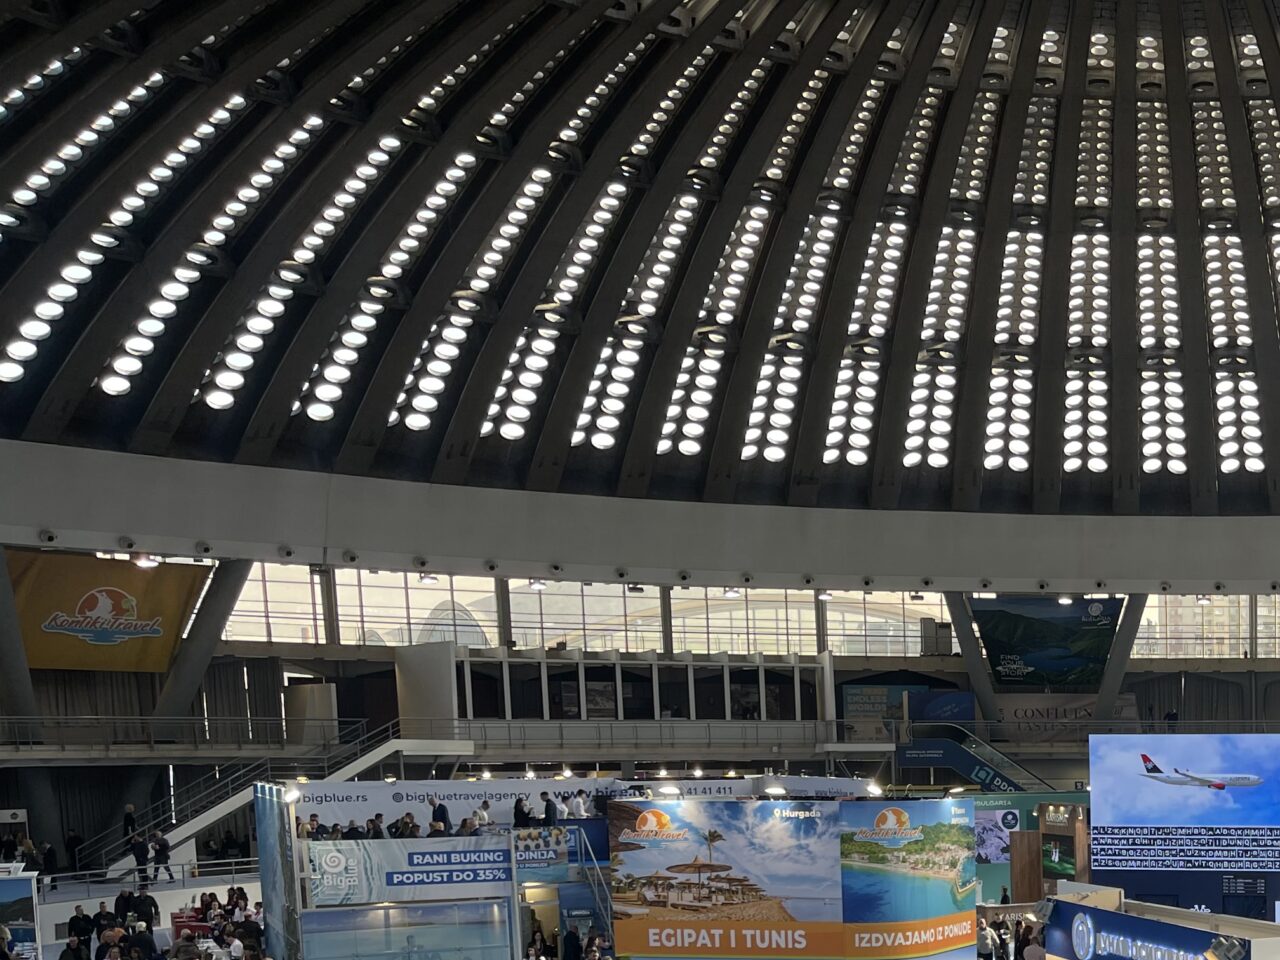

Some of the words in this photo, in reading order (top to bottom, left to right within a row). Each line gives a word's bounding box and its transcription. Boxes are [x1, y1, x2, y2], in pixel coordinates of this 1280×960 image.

[108, 616, 161, 631] Travel
[701, 785, 713, 796] 41
[715, 785, 733, 796] 411
[302, 792, 368, 805] bigblue.rs
[782, 809, 821, 819] Hurgada
[413, 852, 448, 864] RANI
[450, 851, 503, 863] BUKING
[345, 858, 359, 886] Blue
[393, 872, 450, 884] POPUST
[452, 871, 474, 882] DO
[476, 869, 506, 882] 35%
[323, 873, 346, 887] Big
[648, 928, 724, 948] EGIPAT
[730, 929, 736, 948] I
[742, 929, 807, 949] TUNIS
[854, 929, 934, 948] IZDVAJAMO
[936, 927, 943, 941] IZ
[944, 920, 972, 938] PONUDE
